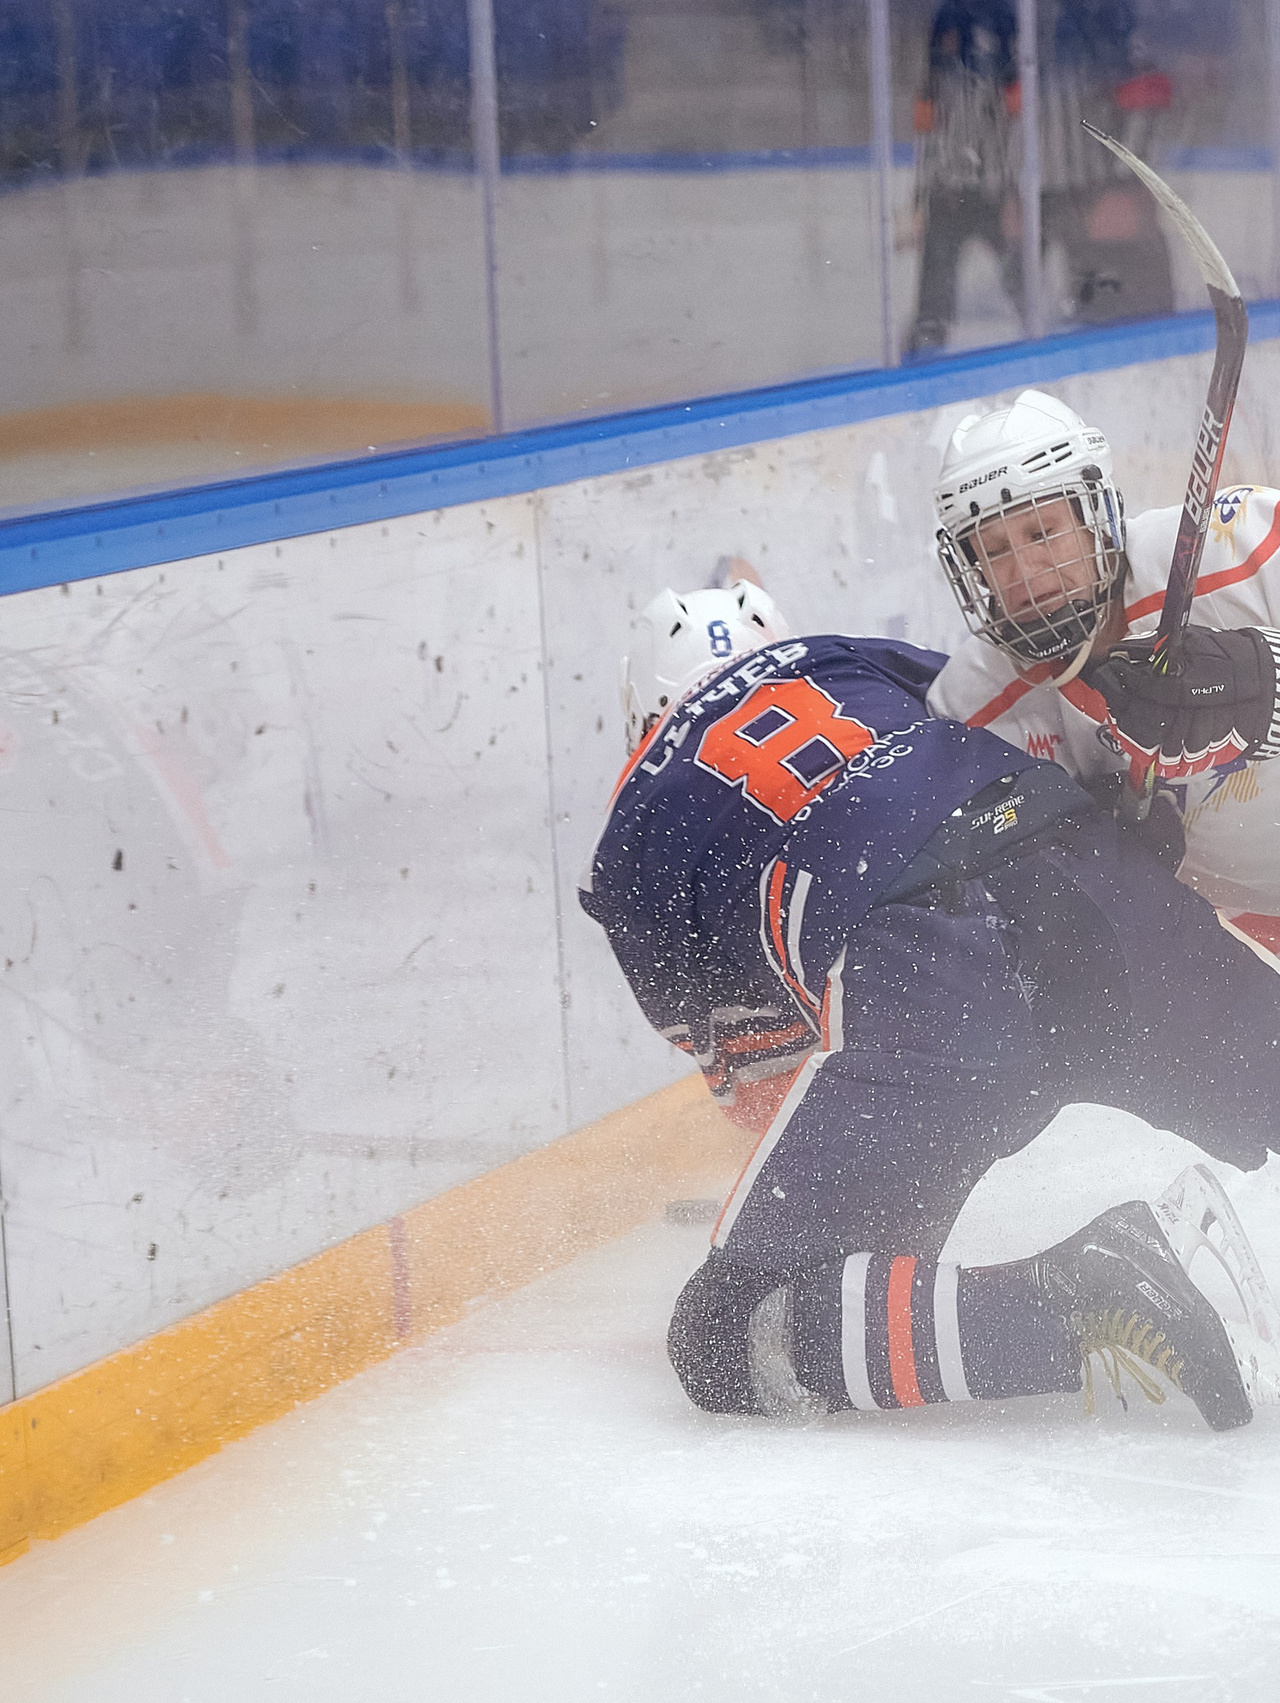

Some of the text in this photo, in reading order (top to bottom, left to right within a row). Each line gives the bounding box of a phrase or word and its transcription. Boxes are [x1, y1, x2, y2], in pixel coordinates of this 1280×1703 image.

[959, 465, 1009, 494] BAUER
[1184, 405, 1224, 526] BAUER
[707, 620, 733, 658] 8
[1191, 684, 1225, 696] ALPHA
[694, 674, 878, 827] 8
